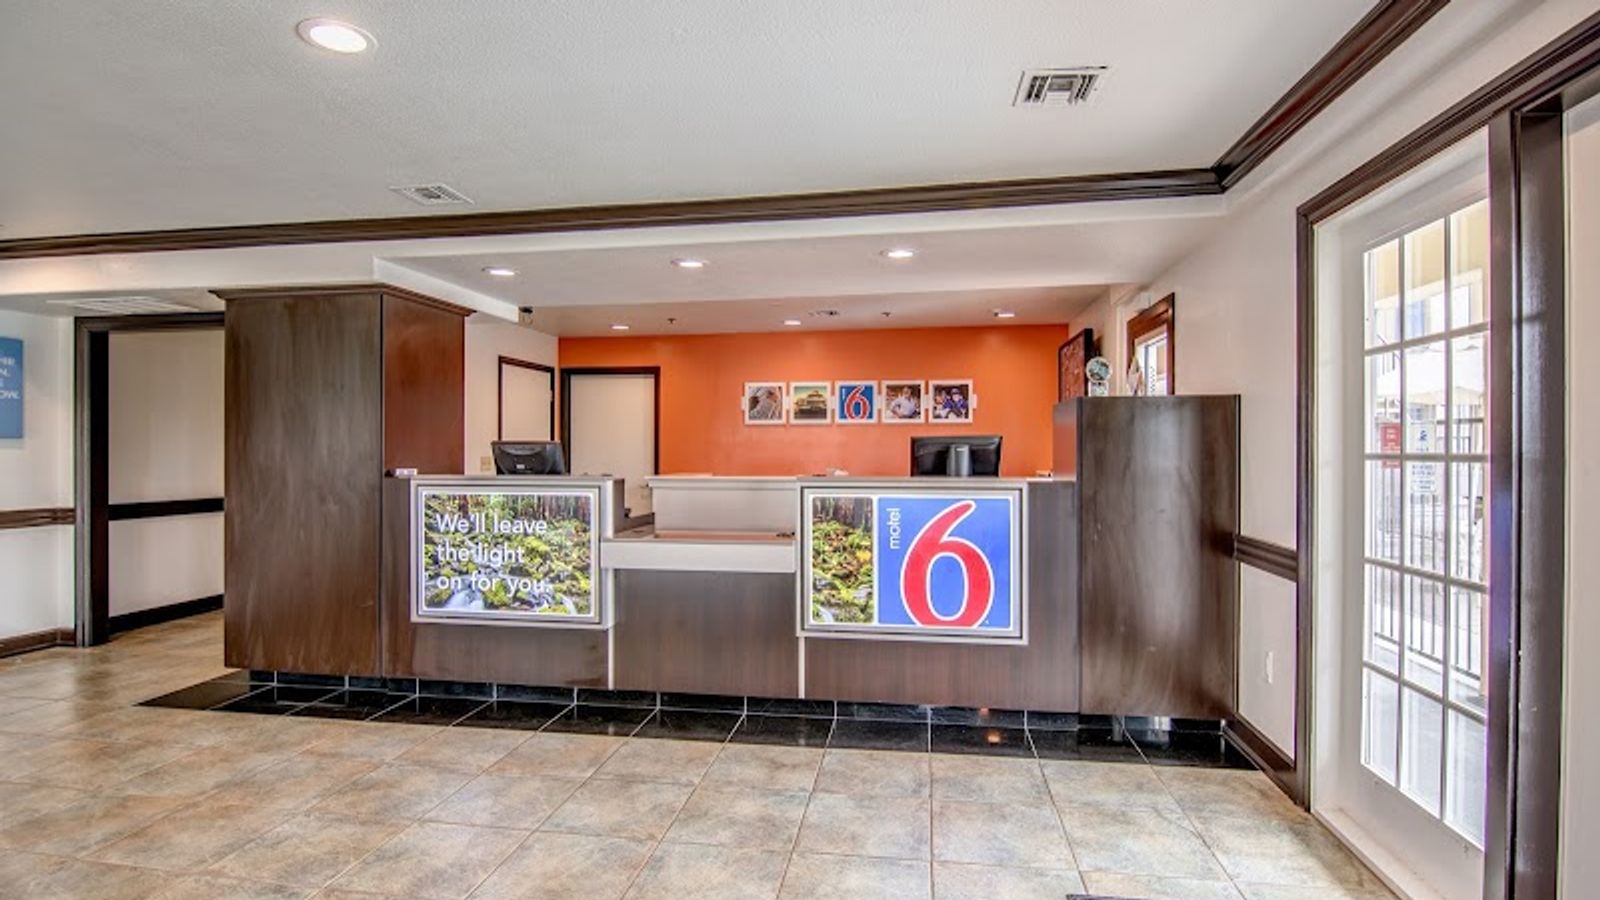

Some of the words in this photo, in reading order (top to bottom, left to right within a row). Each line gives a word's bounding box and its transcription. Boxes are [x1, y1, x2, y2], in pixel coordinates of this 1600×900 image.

[844, 384, 871, 420] 6
[436, 513, 486, 533] We'll
[494, 513, 548, 533] leave
[886, 507, 901, 550] motel
[437, 539, 471, 562] the
[475, 541, 526, 567] light
[900, 499, 995, 629] 6
[436, 575, 462, 590] on
[470, 570, 499, 591] for
[506, 579, 553, 598] you.
